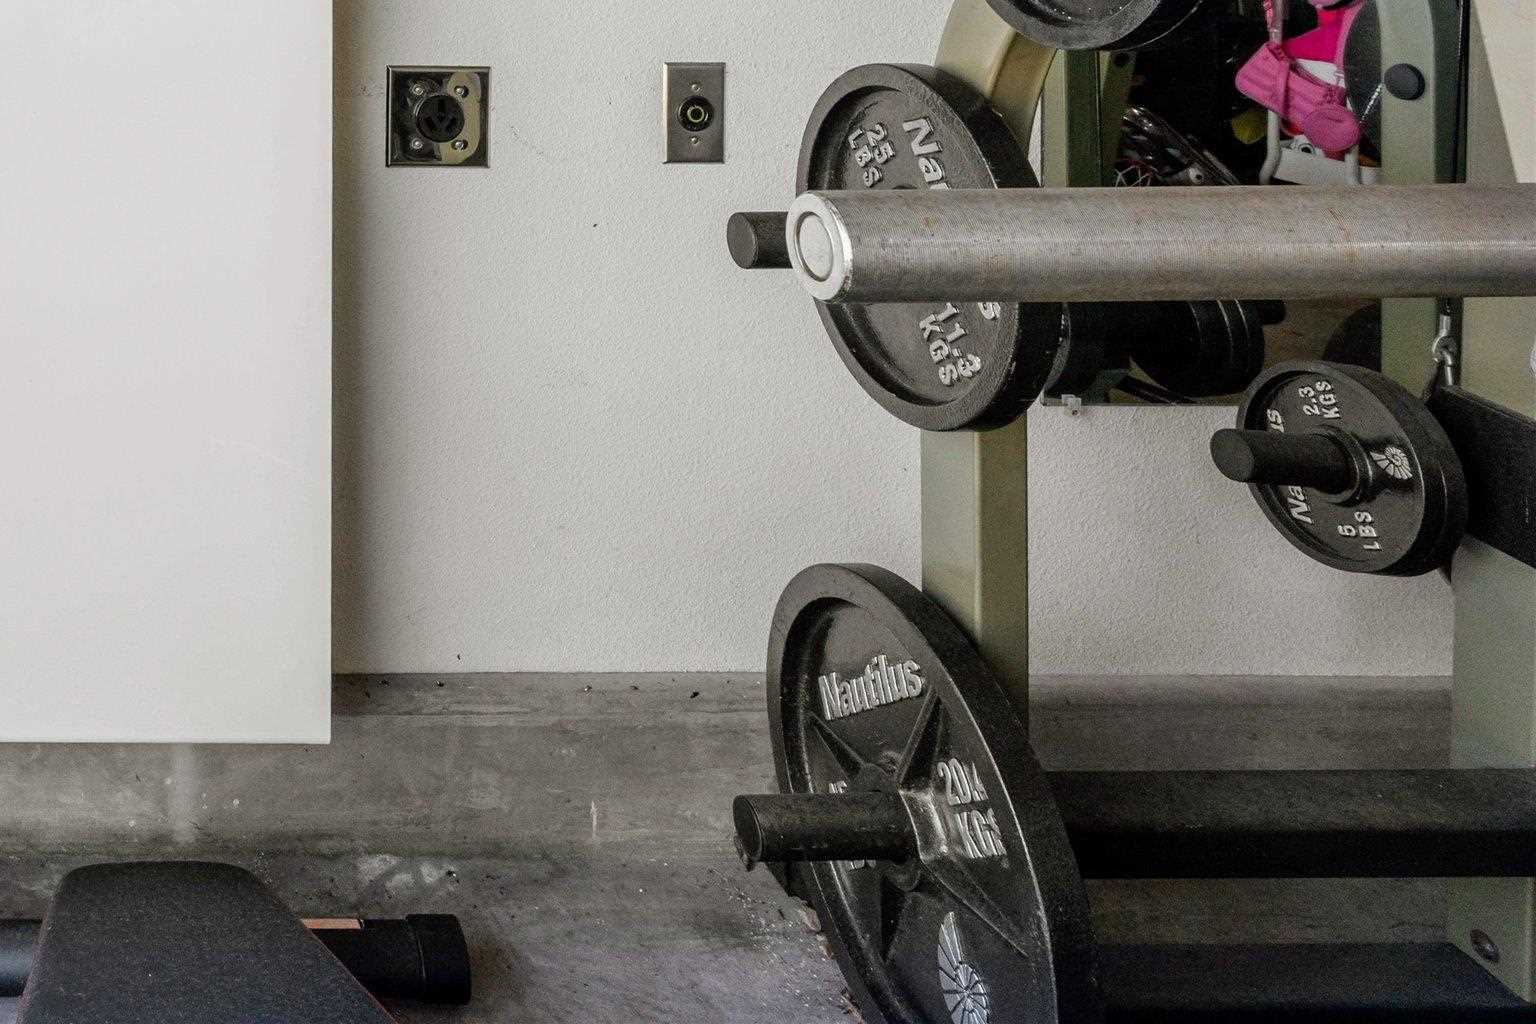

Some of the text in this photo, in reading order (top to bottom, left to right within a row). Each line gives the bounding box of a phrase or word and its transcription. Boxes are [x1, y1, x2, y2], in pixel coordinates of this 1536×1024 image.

[847, 128, 884, 189] LBS
[865, 123, 897, 166] 25
[918, 312, 959, 387] KGS
[936, 302, 982, 379] 11.3
[1298, 385, 1321, 417] 2.3
[1315, 380, 1341, 420] KGS
[1353, 510, 1383, 552] LBS
[818, 654, 925, 721] Nautilus
